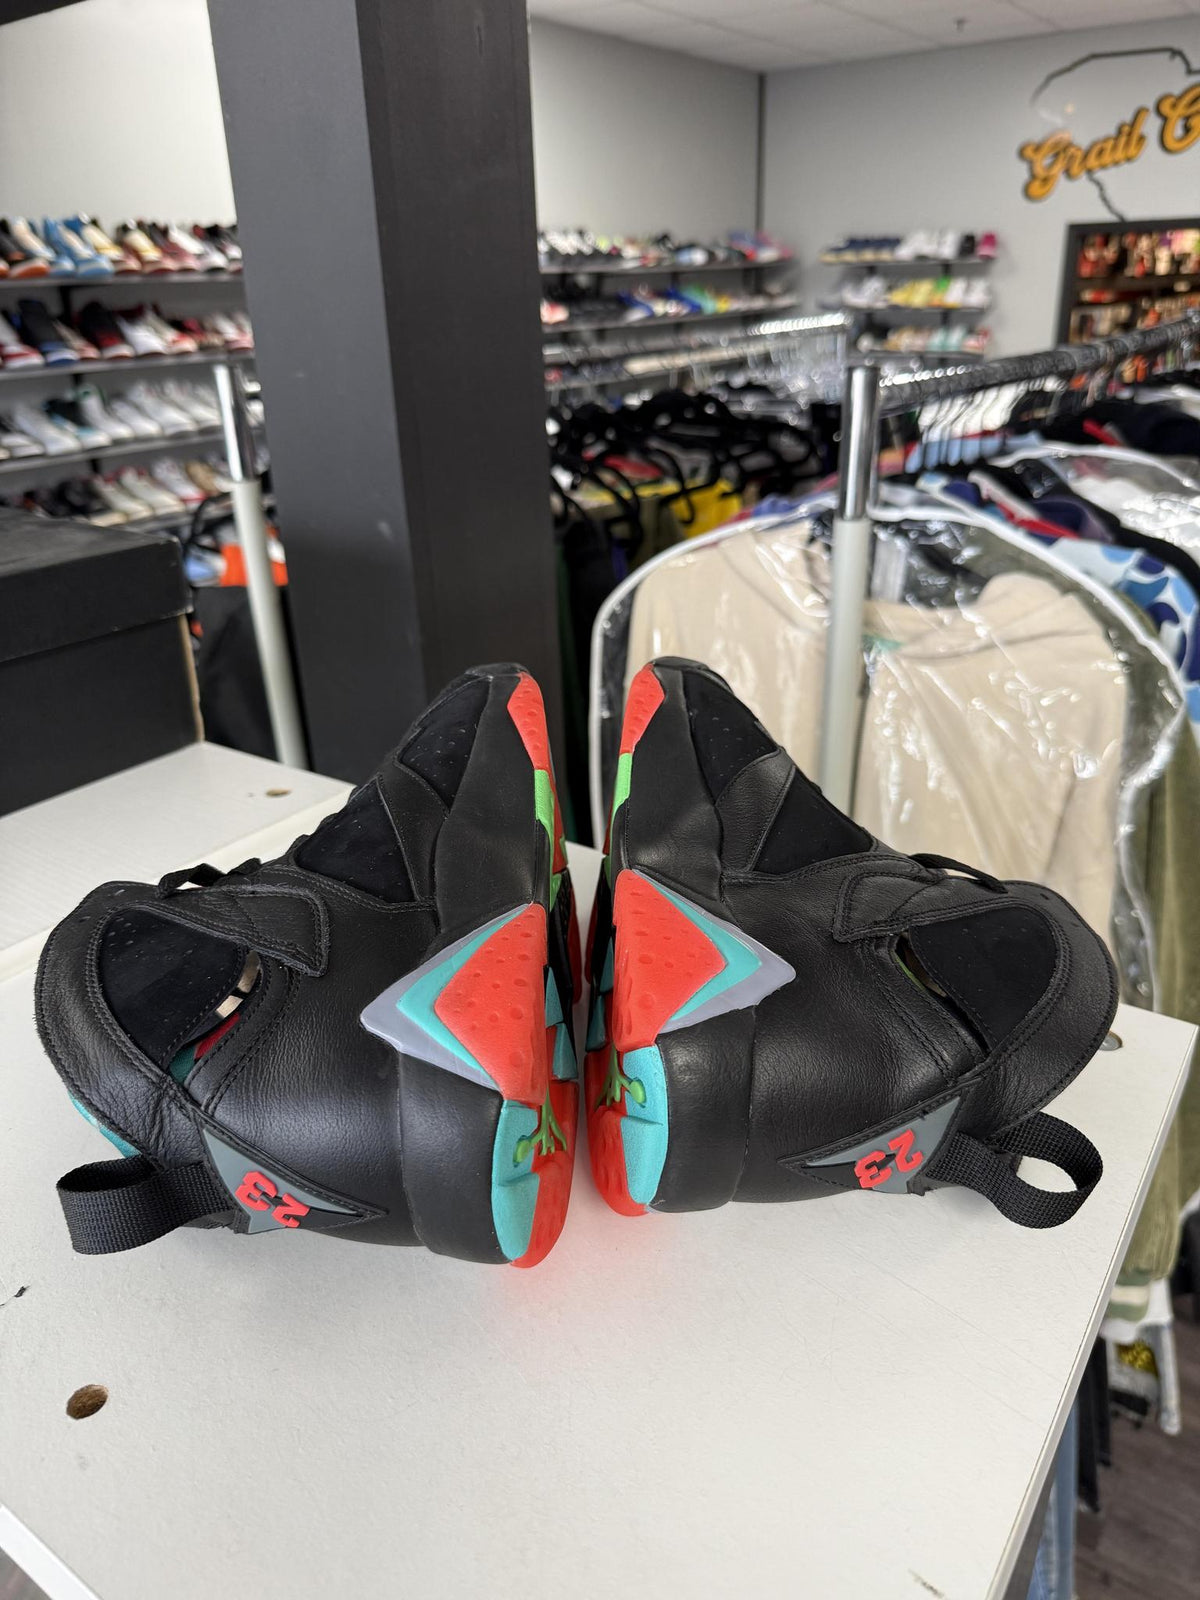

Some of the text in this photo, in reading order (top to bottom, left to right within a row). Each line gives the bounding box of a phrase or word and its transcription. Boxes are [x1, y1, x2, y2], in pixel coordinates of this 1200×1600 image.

[1019, 107, 1149, 201] Grail
[854, 1129, 924, 1189] 23
[235, 1171, 310, 1228] 23
